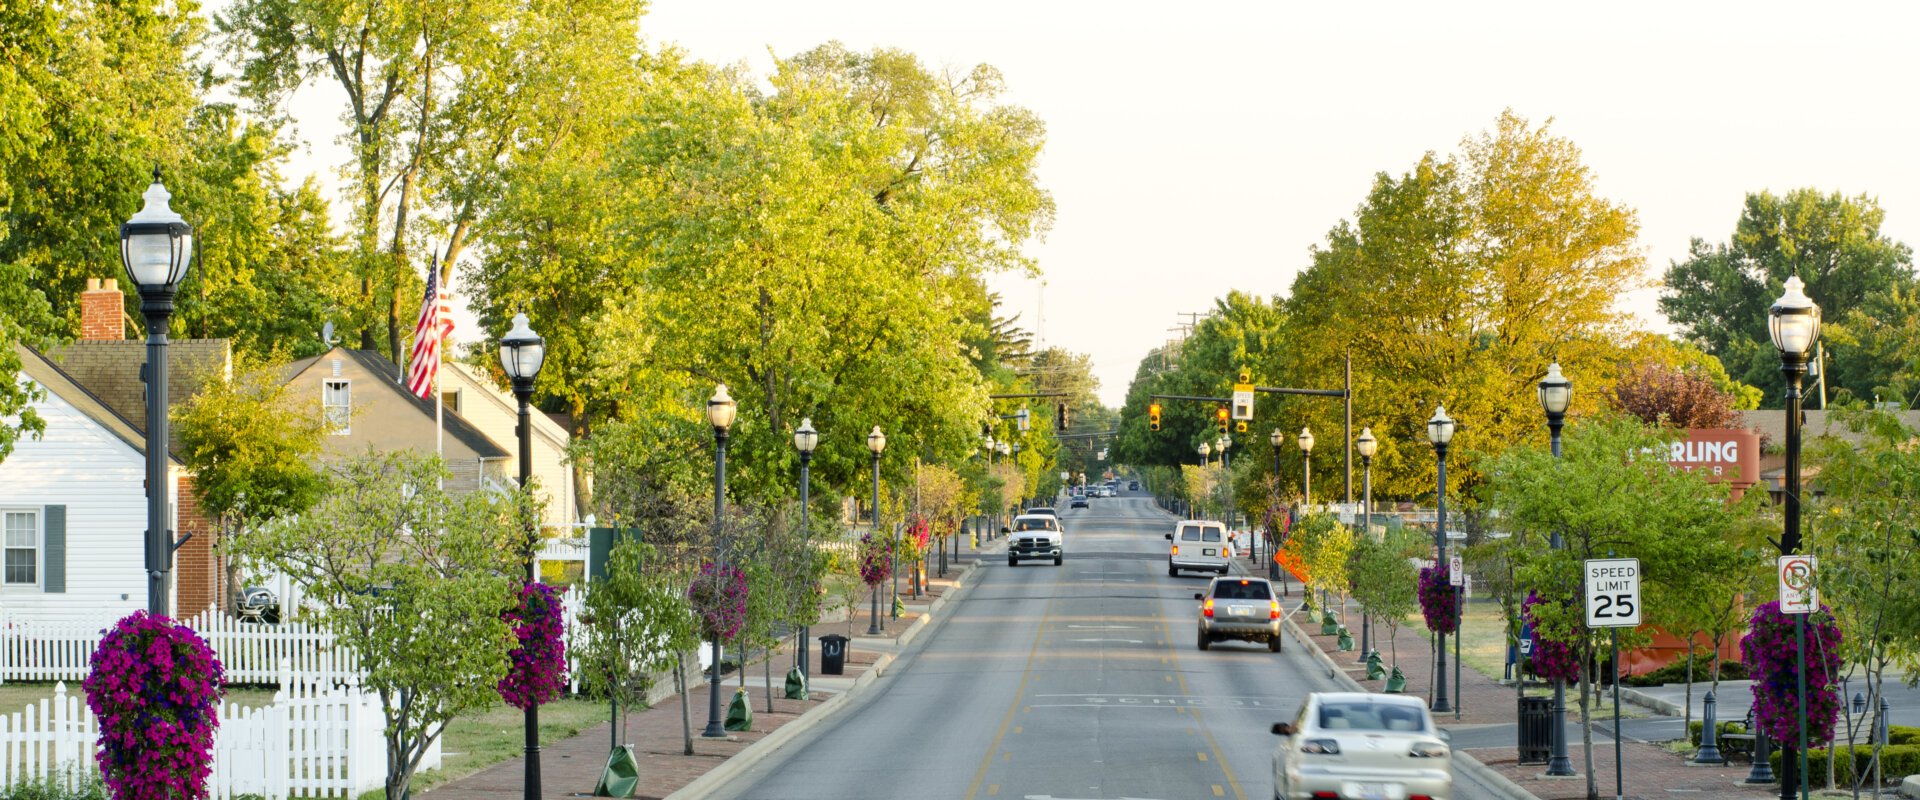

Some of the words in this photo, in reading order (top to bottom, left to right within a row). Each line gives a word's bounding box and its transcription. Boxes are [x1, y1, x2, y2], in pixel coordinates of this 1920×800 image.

[1628, 441, 1738, 463] RLING
[1591, 567, 1636, 578] SPEED
[1596, 581, 1631, 592] LIMIT
[1594, 594, 1635, 618] 25
